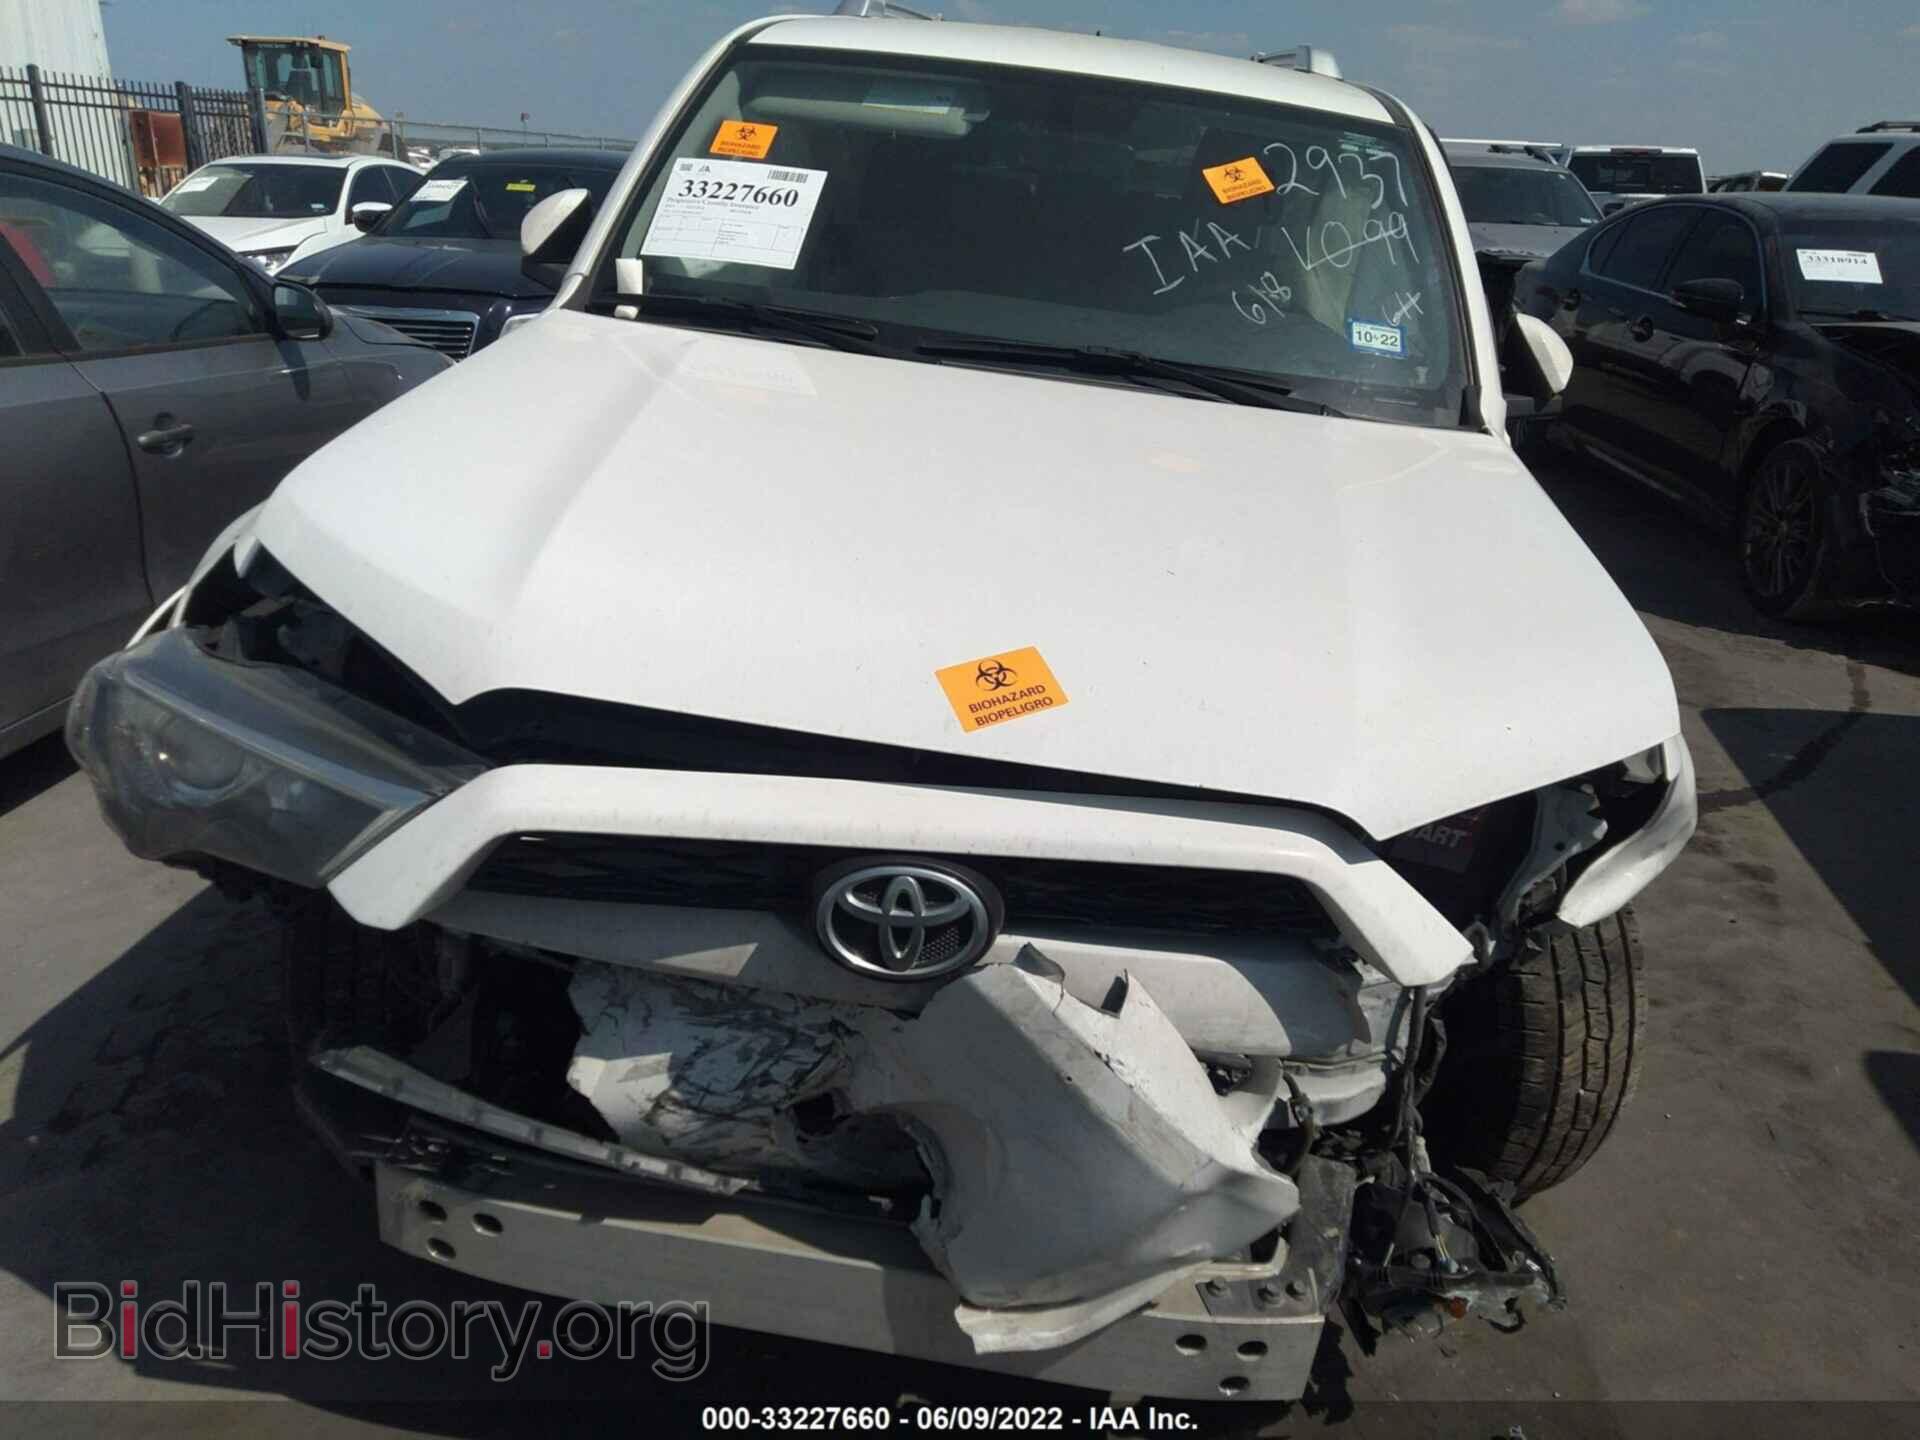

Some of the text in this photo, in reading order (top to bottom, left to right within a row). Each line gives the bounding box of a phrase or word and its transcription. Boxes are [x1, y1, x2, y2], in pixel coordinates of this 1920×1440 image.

[678, 179, 799, 208] 33227660
[968, 684, 1047, 714] BIOHAZARD
[974, 696, 1054, 727] BIOPELIGRO
